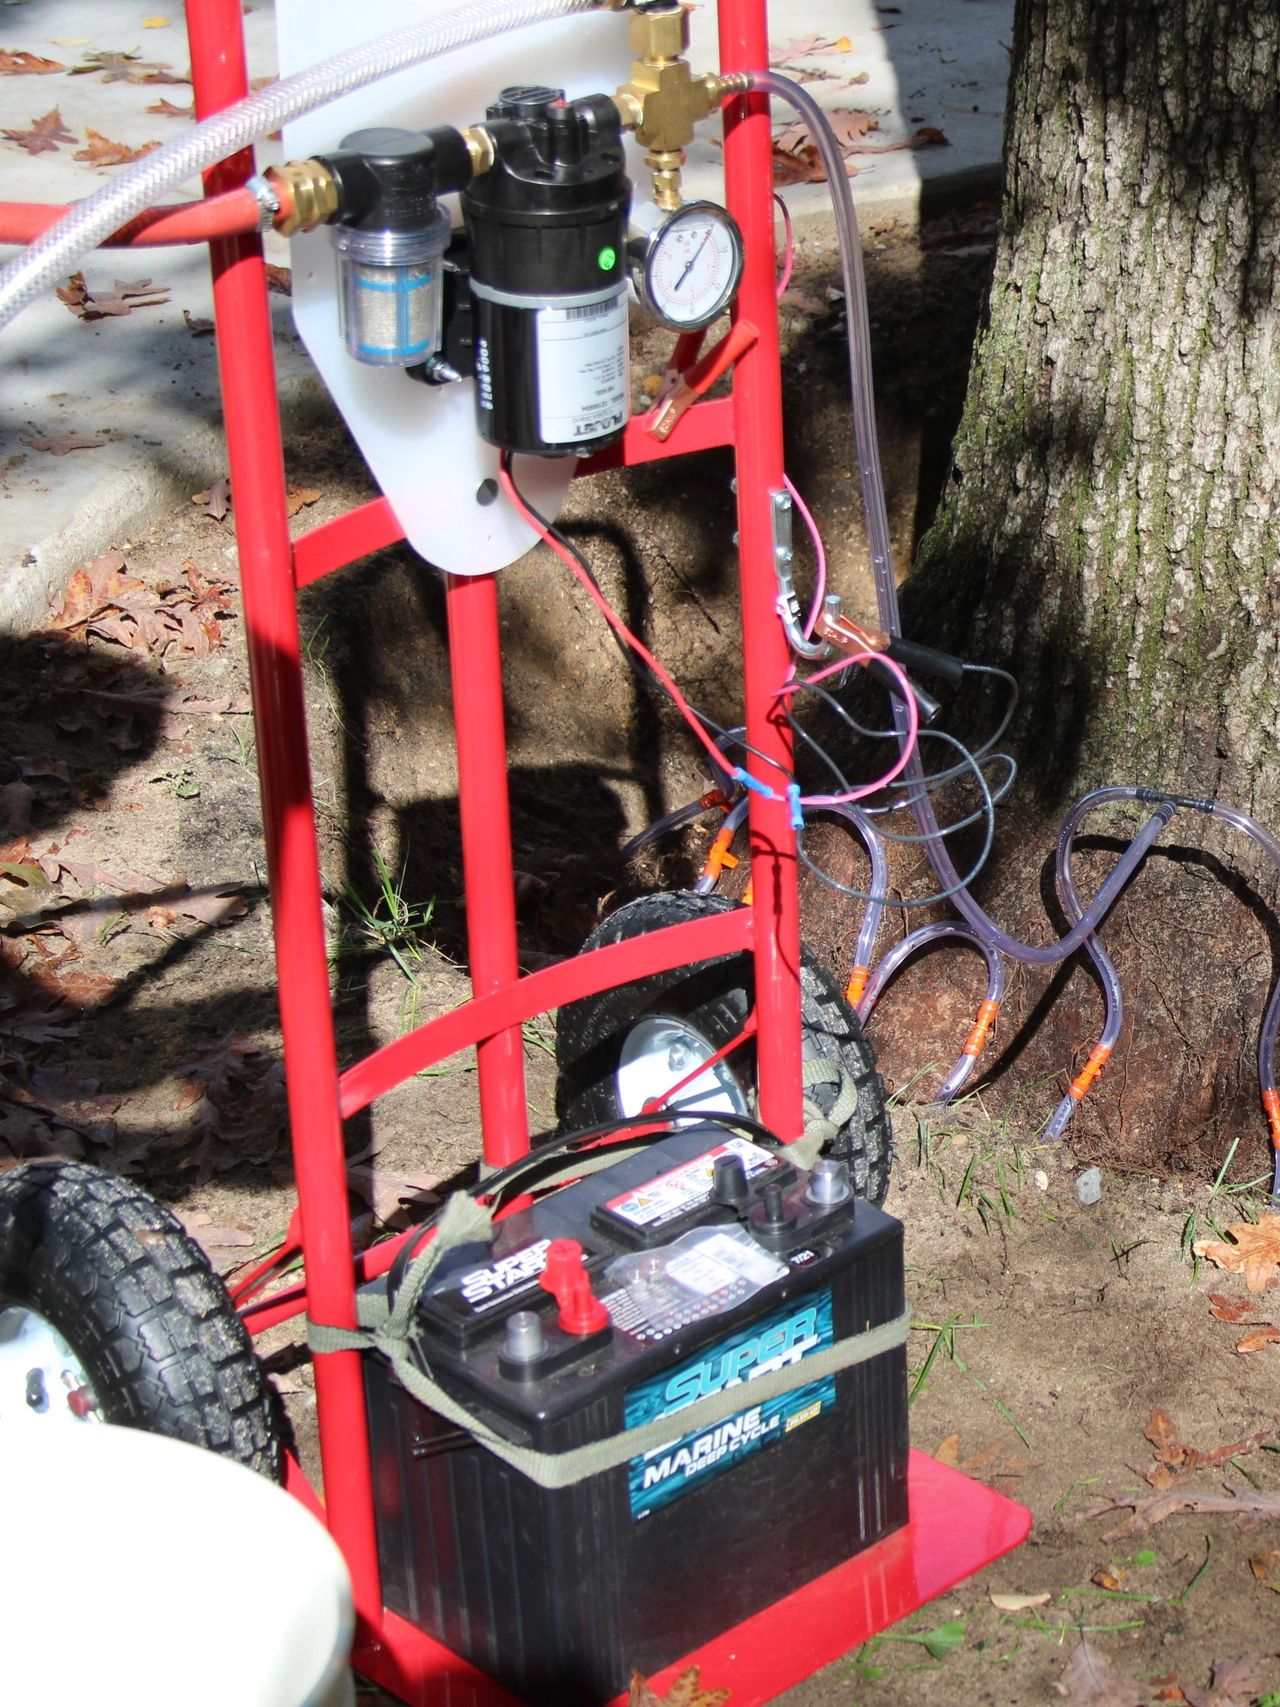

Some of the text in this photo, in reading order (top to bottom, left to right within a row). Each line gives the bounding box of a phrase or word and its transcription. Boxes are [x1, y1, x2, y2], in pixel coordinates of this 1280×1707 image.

[461, 1238, 551, 1285] SUPER
[461, 1250, 549, 1303] STAR
[663, 1306, 818, 1417] SUPER
[643, 1406, 763, 1489] MARINE
[684, 1443, 728, 1478] DEEP
[728, 1414, 781, 1452] CYCLE
